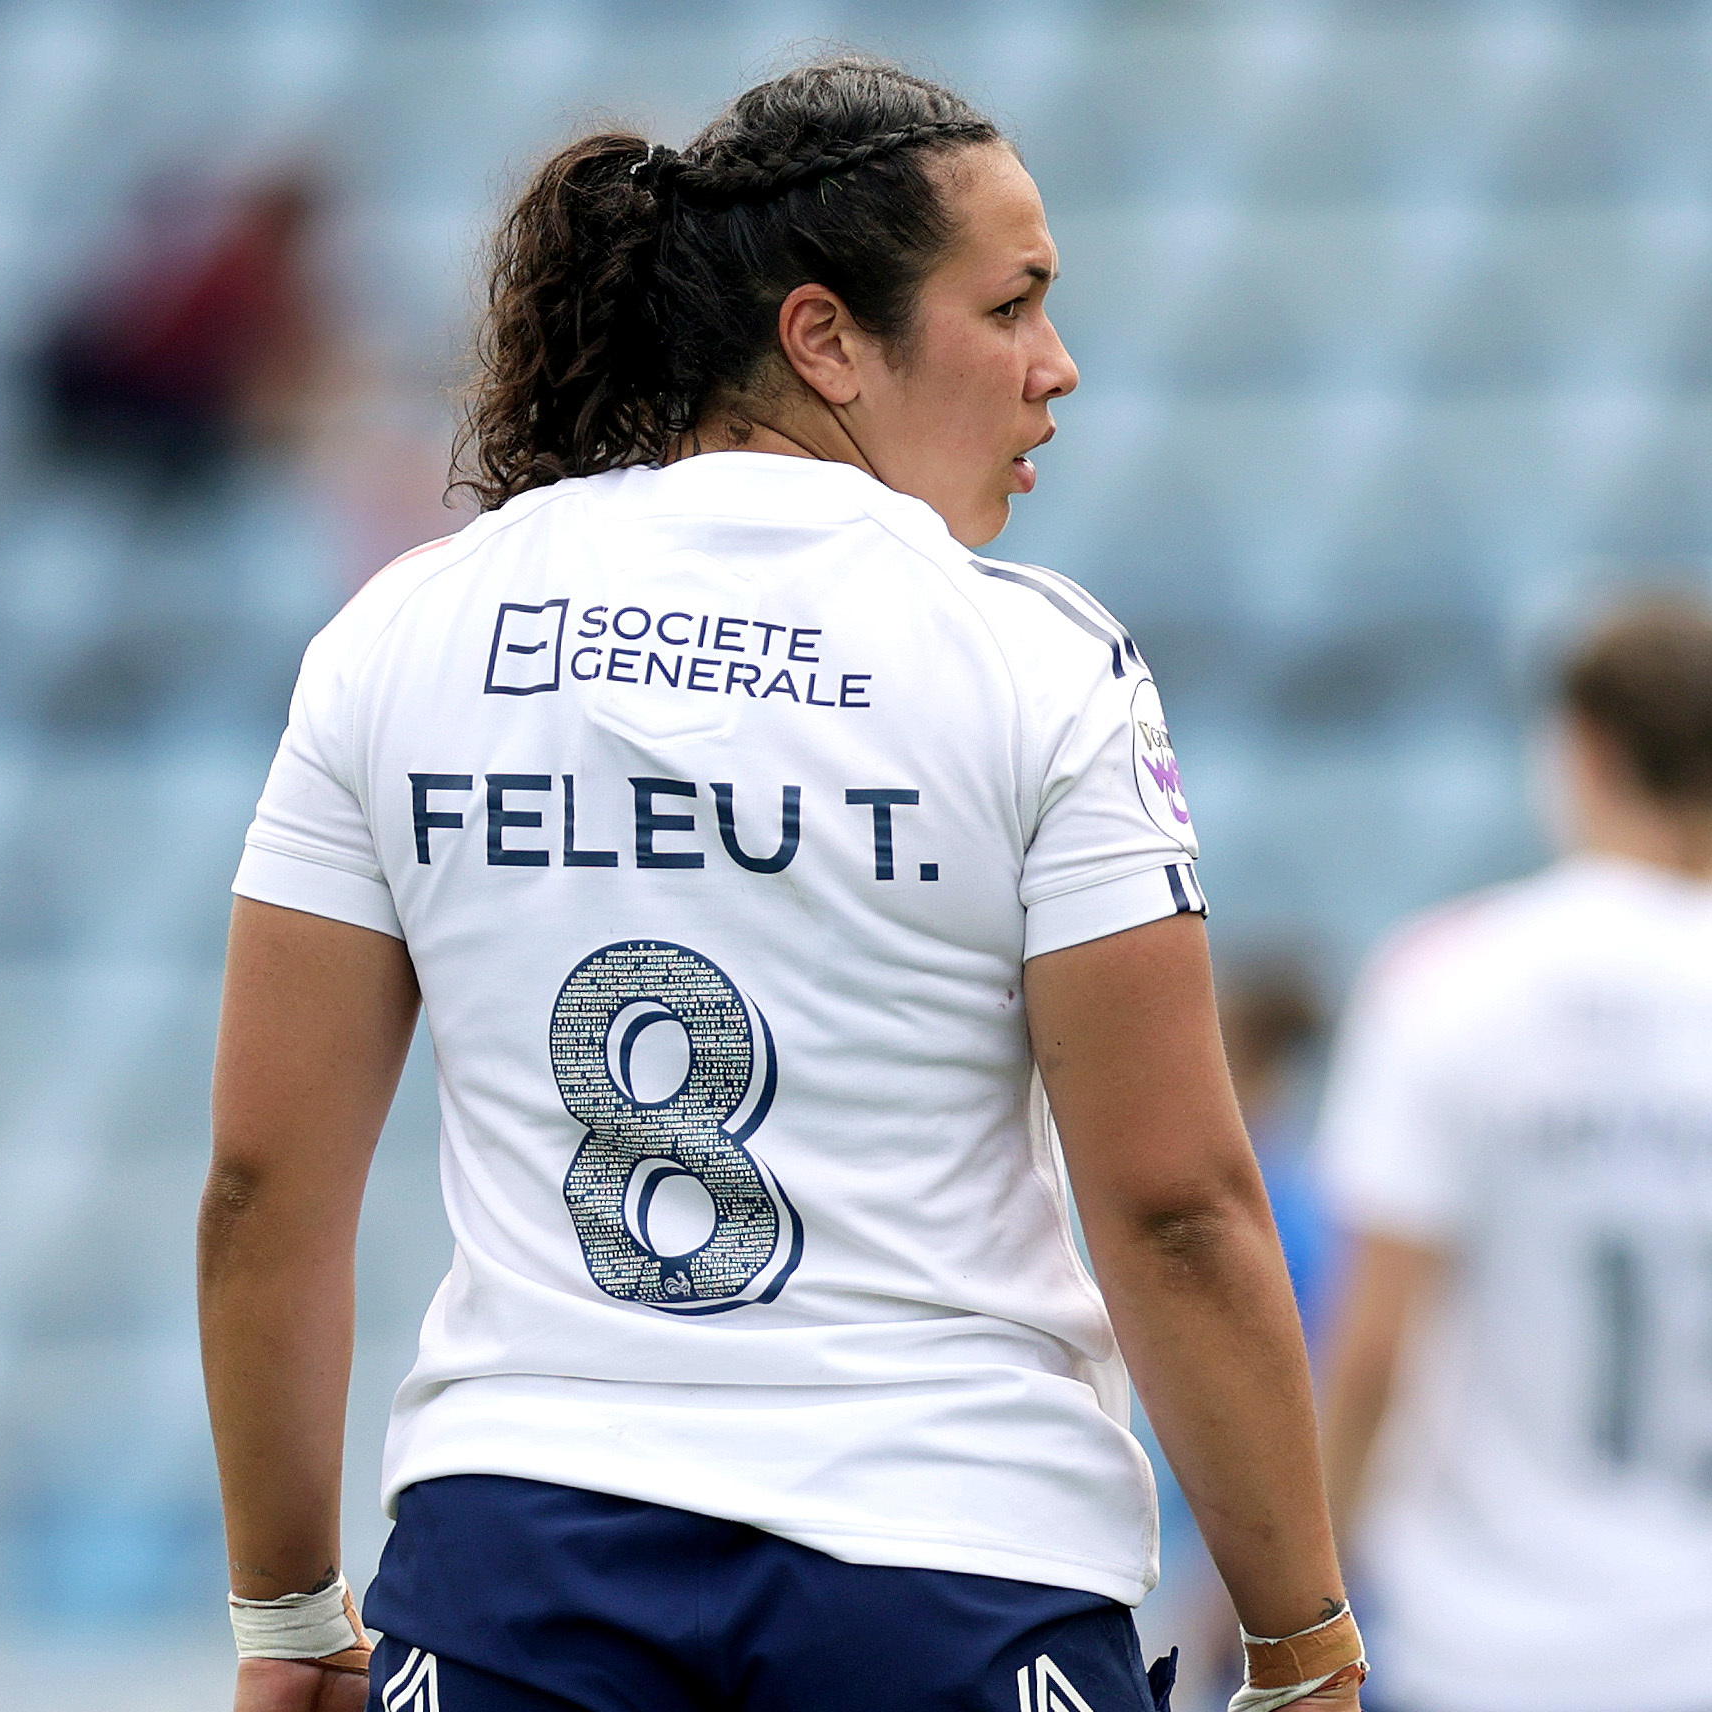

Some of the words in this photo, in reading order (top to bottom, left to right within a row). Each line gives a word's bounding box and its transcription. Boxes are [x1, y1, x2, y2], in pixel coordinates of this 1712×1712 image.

[570, 646, 872, 708] GENERALE
[577, 605, 822, 663] SOCIETE
[408, 772, 802, 875] FELEU
[845, 788, 939, 882] T.
[549, 940, 805, 1316] 8
